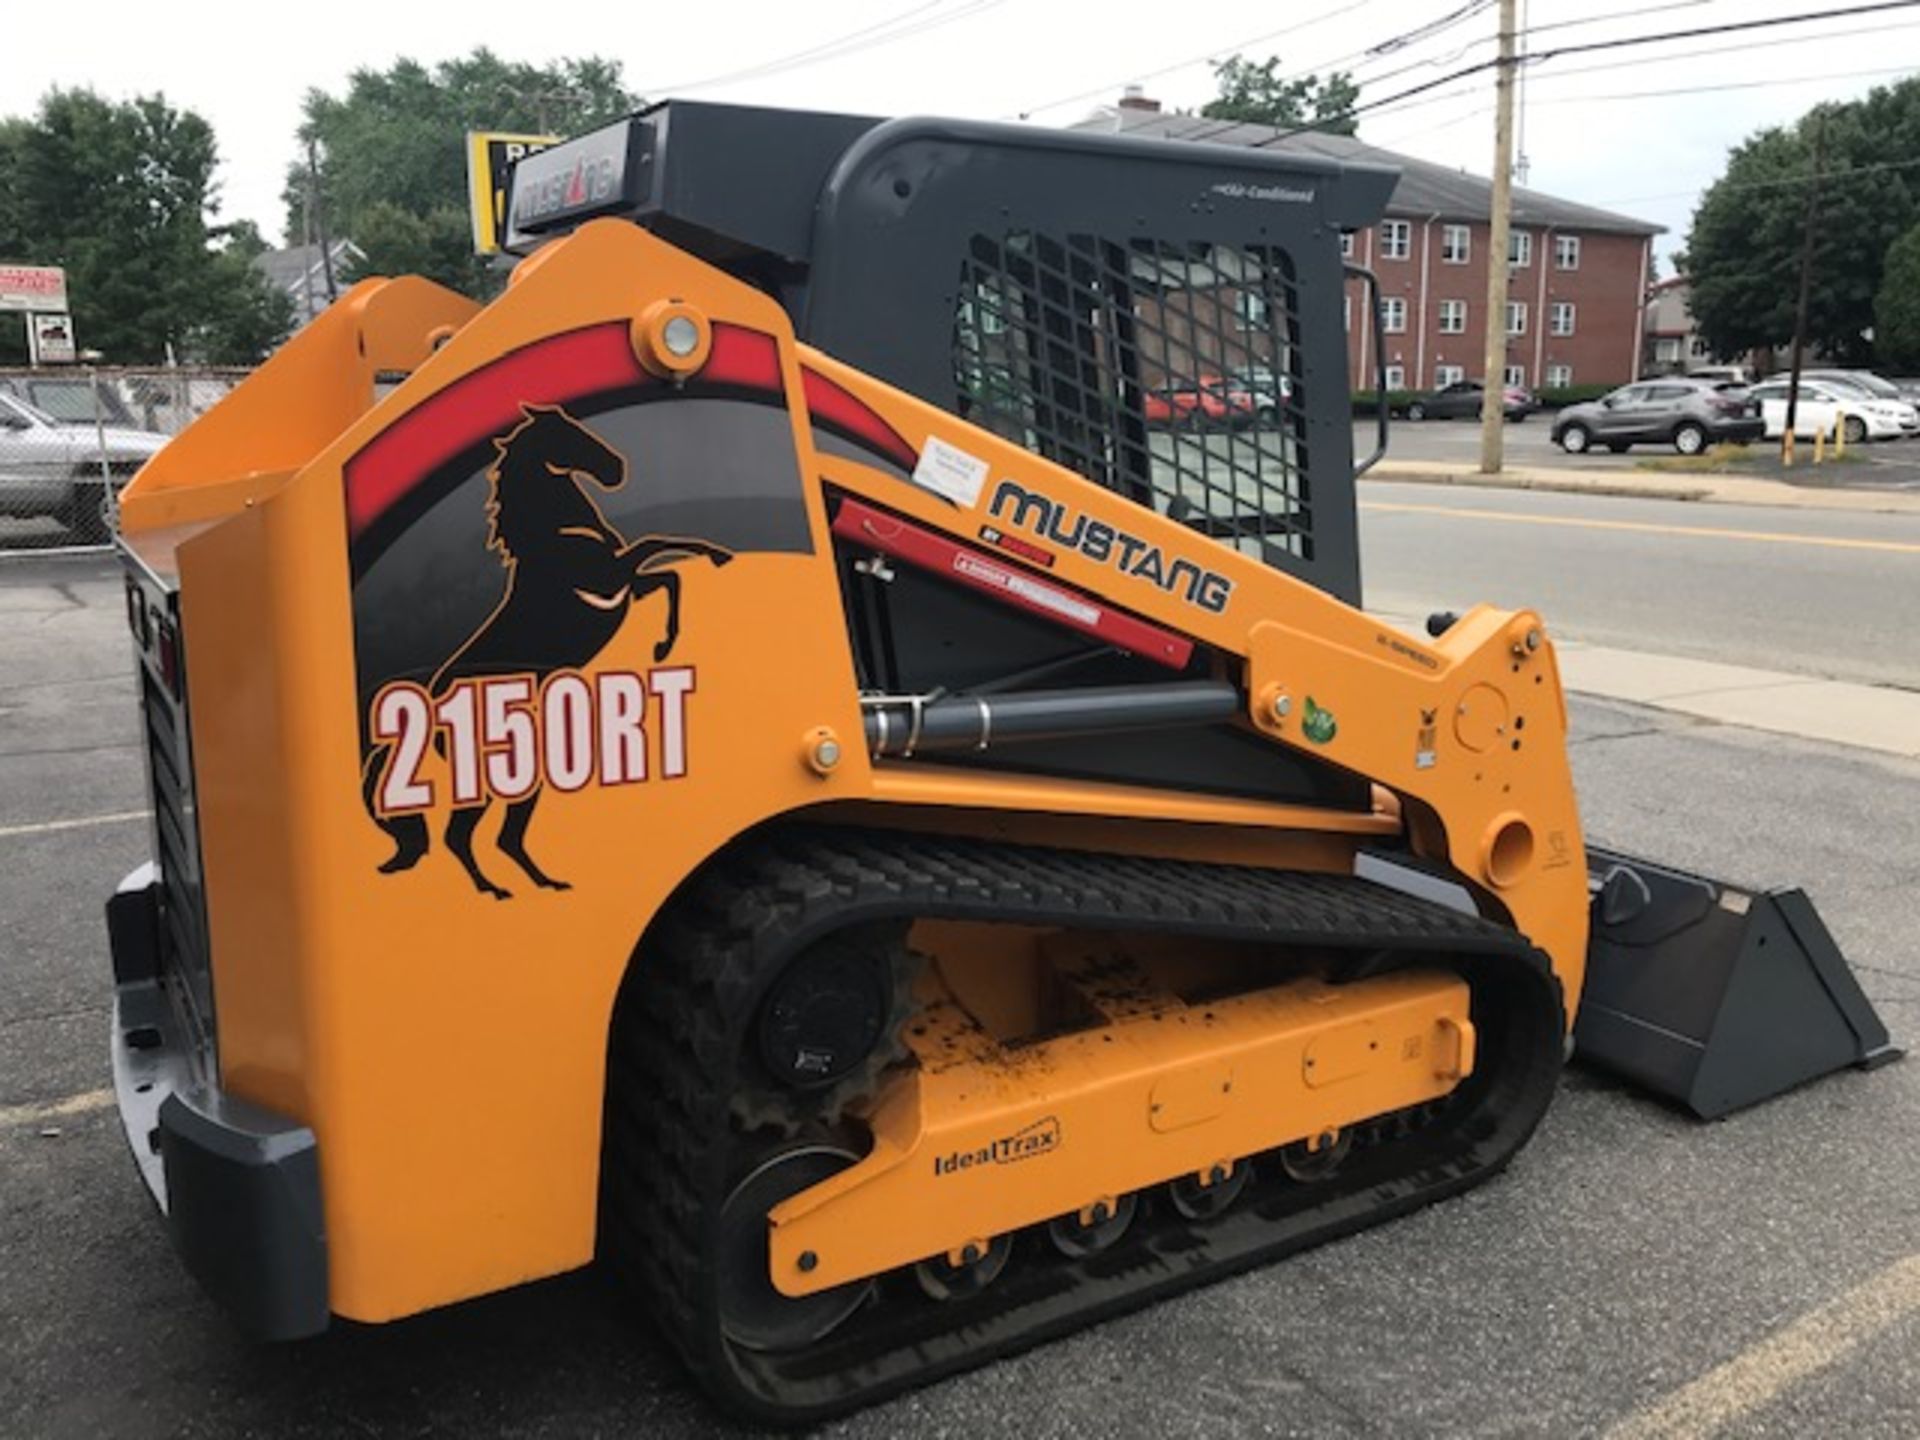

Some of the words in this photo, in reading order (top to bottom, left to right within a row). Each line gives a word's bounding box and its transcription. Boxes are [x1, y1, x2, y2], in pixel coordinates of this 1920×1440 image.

[990, 480, 1233, 614] MUSTANG
[374, 665, 697, 813] 2150RT
[934, 1131, 1055, 1177] IdealTrax
